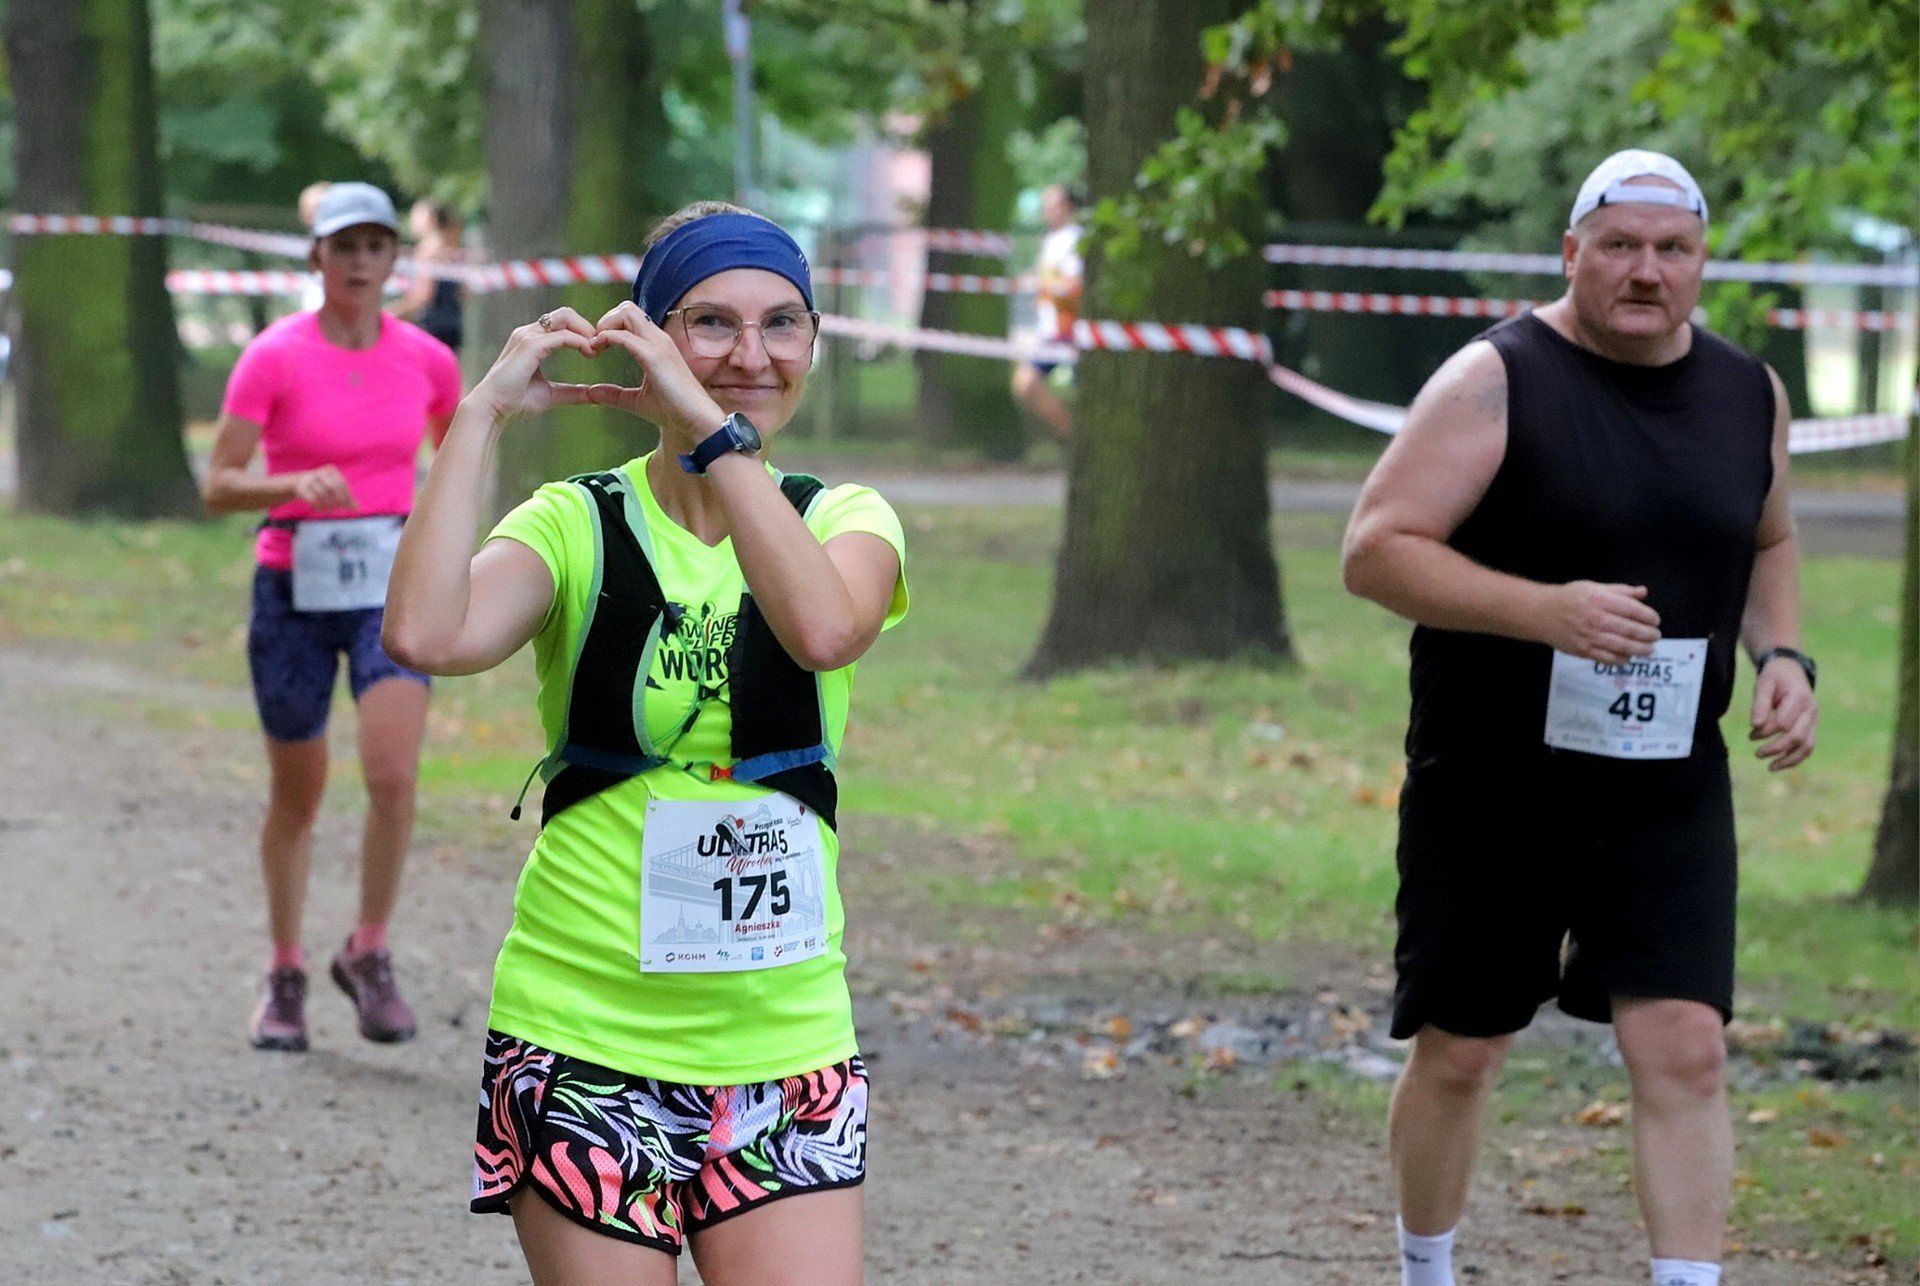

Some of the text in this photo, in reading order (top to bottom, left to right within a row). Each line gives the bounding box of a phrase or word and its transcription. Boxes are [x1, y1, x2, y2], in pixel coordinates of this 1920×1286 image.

[684, 614, 738, 639] WING
[658, 648, 727, 682] WOR
[1608, 691, 1656, 722] 49
[697, 829, 788, 857] ULTRA5
[713, 869, 791, 922] 175
[735, 921, 780, 935] Agnieszka
[677, 953, 706, 961] KGHM
